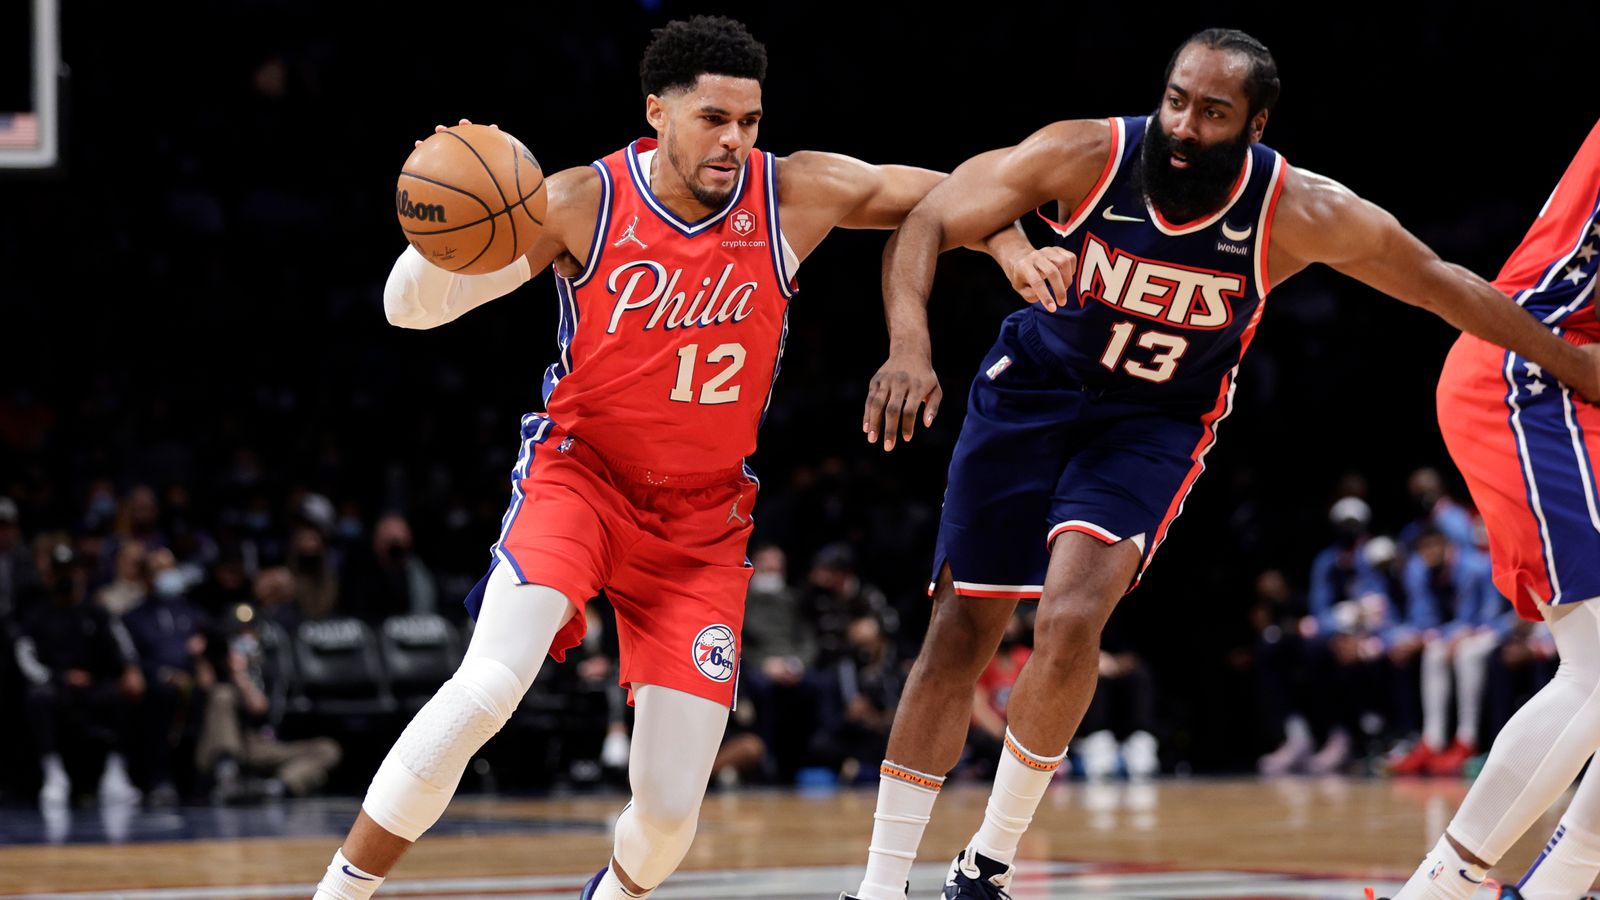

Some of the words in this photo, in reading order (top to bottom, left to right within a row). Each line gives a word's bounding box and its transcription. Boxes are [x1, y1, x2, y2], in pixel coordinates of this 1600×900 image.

[721, 240, 766, 249] crypto.com
[1217, 242, 1248, 255] Webull
[606, 259, 758, 335] Phila
[1077, 233, 1245, 330] NETS
[669, 342, 747, 405] 12
[1100, 320, 1190, 384] 13
